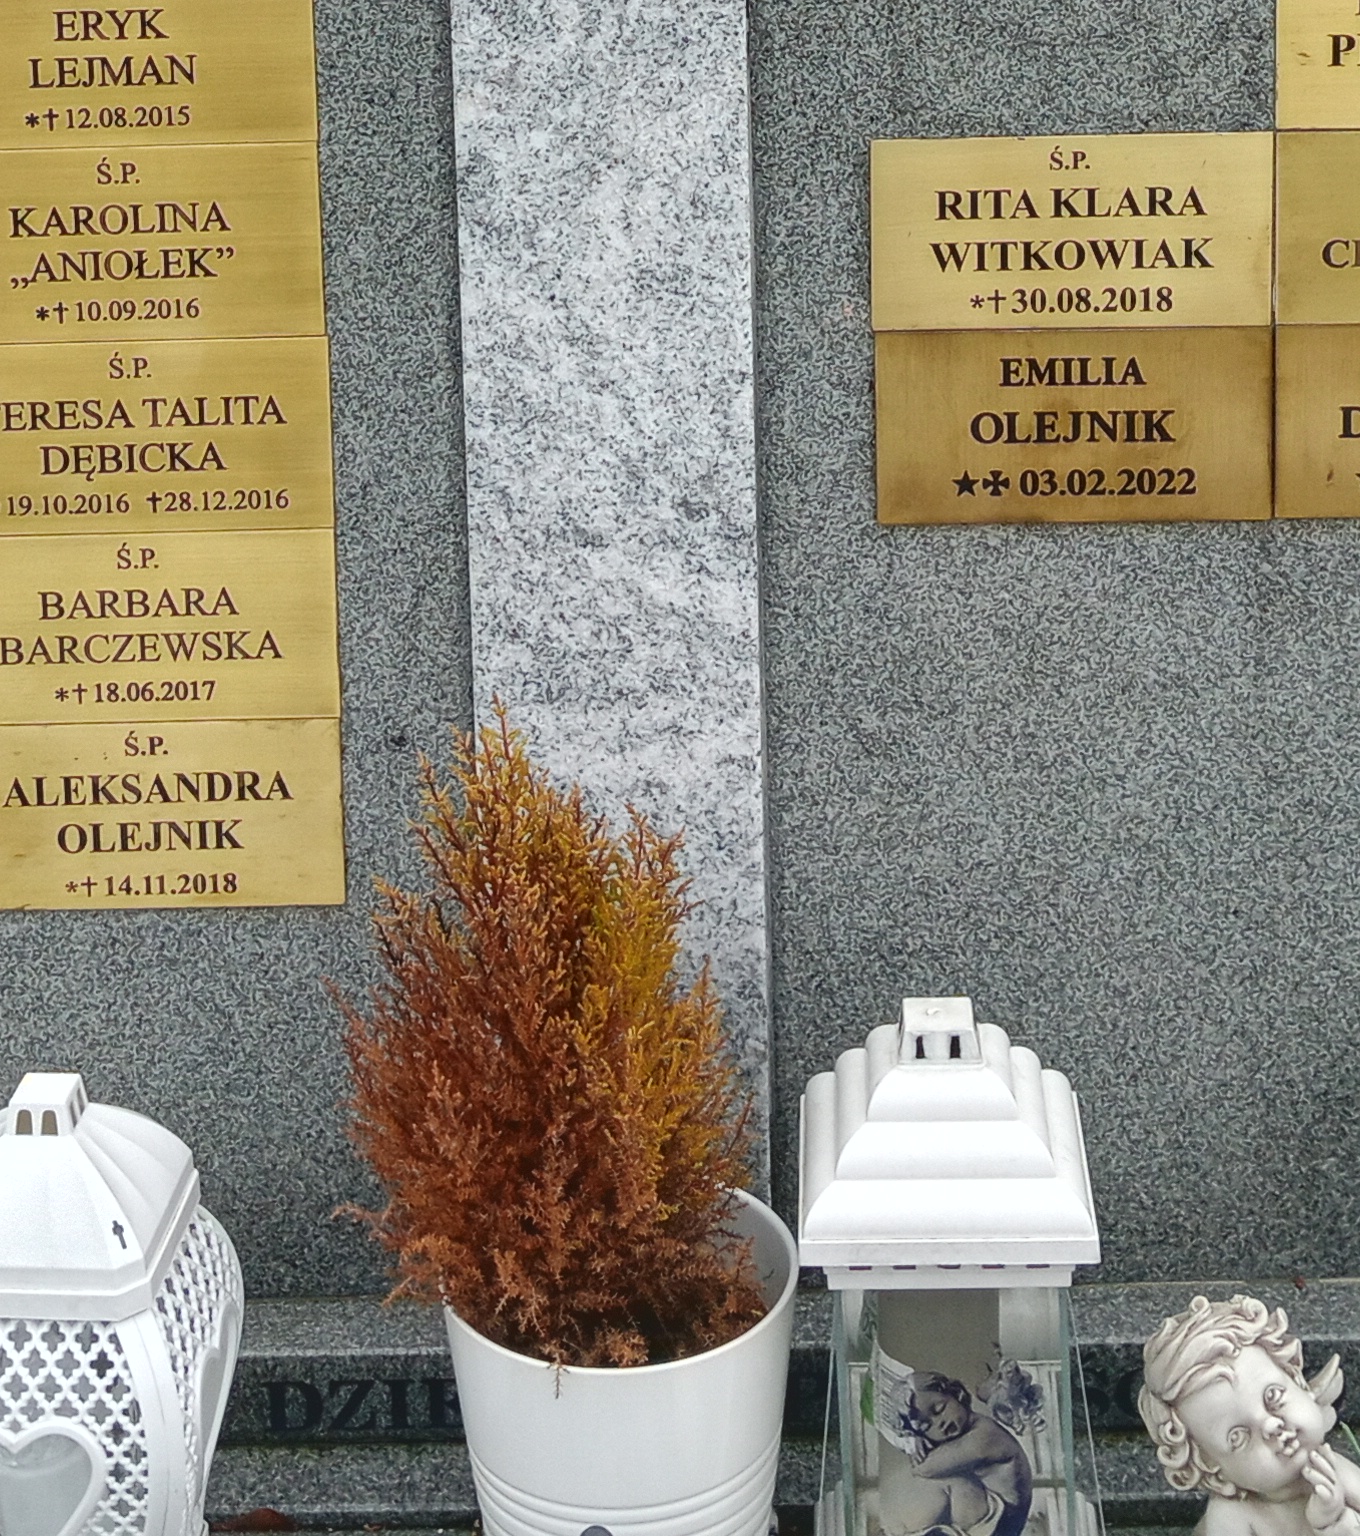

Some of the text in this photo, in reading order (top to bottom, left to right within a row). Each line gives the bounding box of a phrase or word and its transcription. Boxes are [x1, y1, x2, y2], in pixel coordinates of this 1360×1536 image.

[52, 8, 170, 42] ERYK
[28, 54, 197, 89] LEJMAN
[96, 156, 140, 185] Ś.P.
[1049, 145, 1091, 171] Ś.P.
[8, 201, 232, 238] KAROLINA
[934, 186, 1208, 221] RITA KLARA
[929, 237, 1215, 273] WITKOWIAK
[108, 351, 152, 380] Ś.P.
[998, 356, 1148, 387] EMILIA
[141, 394, 288, 428] TALITA
[970, 409, 1177, 445] OLEJNIK
[39, 441, 228, 482] DĘBICKA
[116, 541, 159, 570] Ś.P.
[37, 586, 240, 621] BARBARA
[124, 730, 169, 757] Ś.P.
[2, 770, 294, 808] ALEKSANDRA
[57, 819, 245, 854] OLEJNIK
[261, 1377, 463, 1432] DZIE
